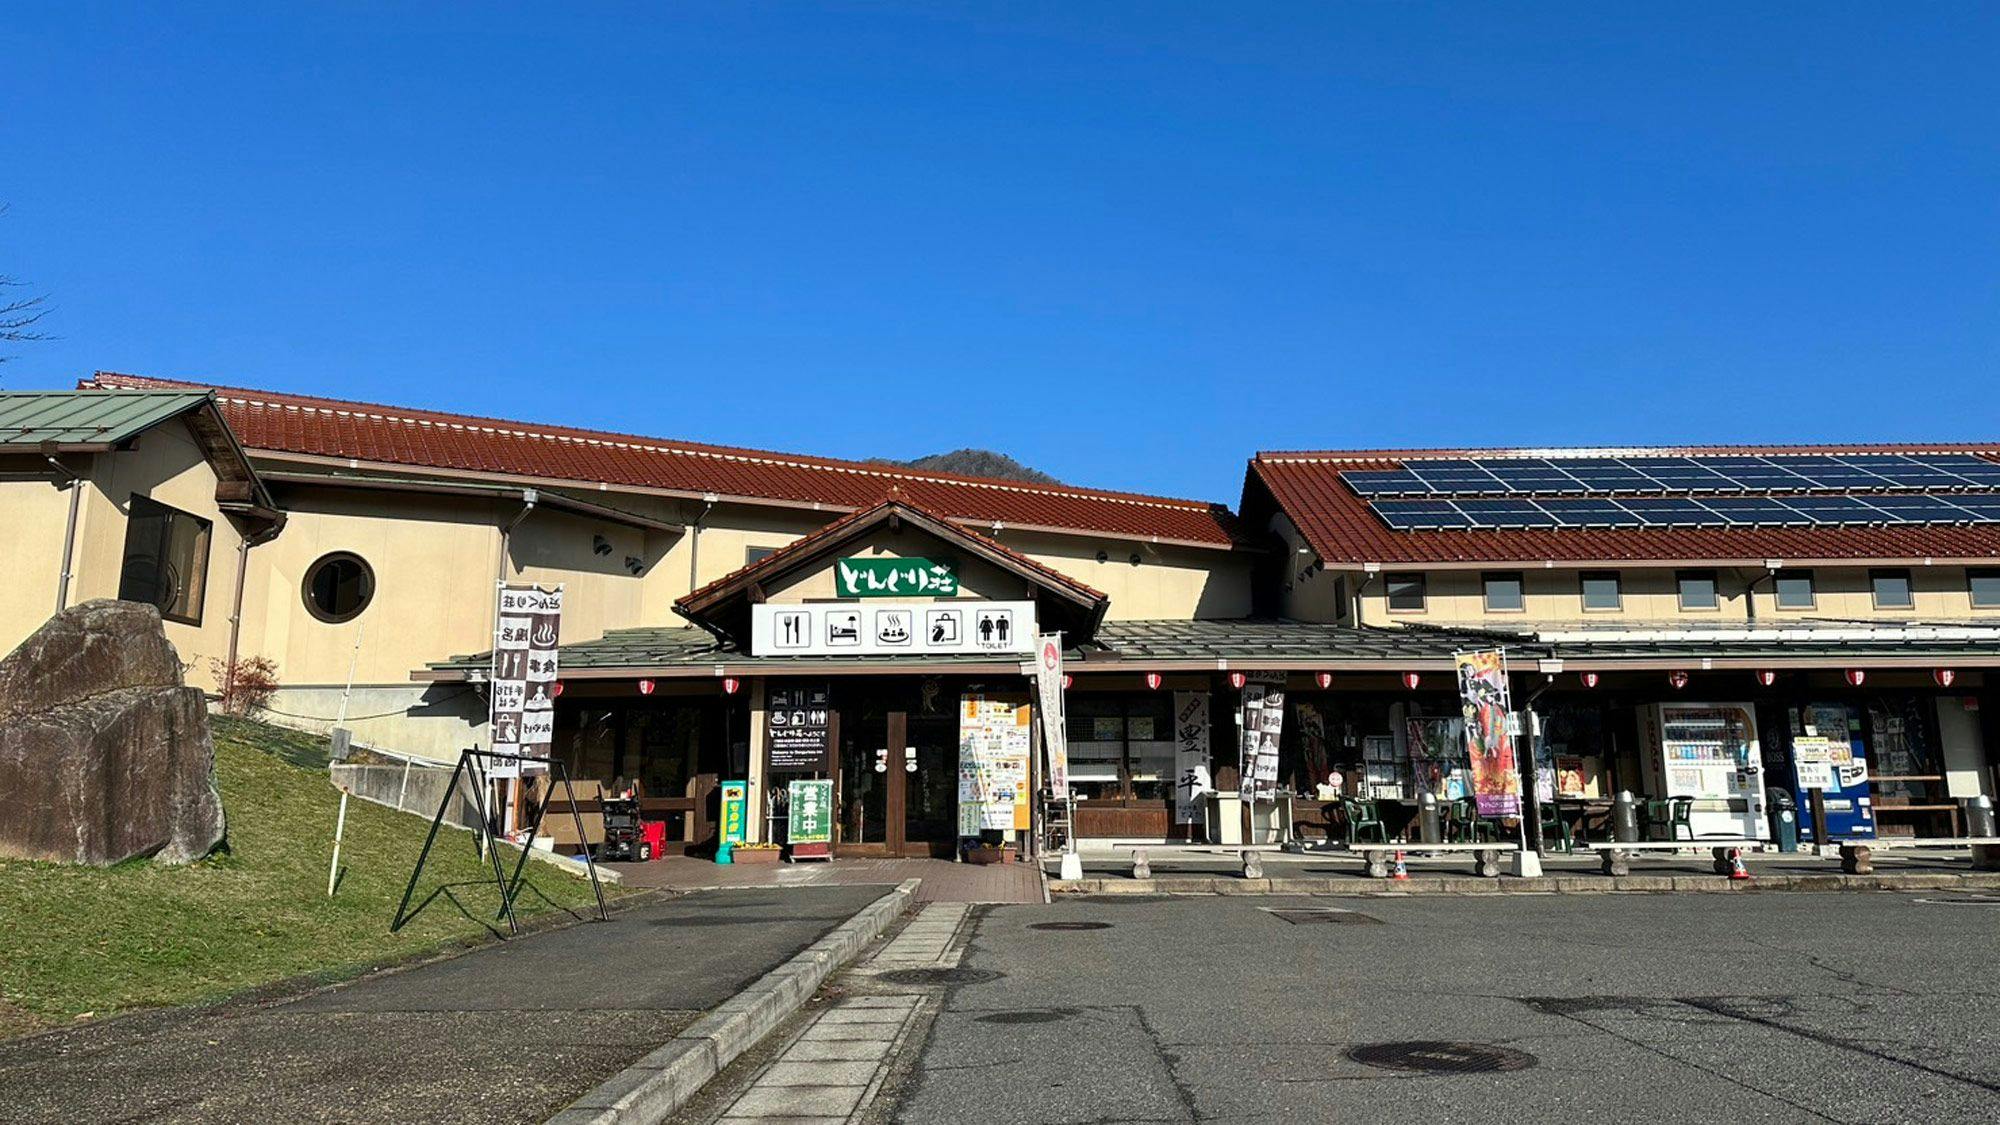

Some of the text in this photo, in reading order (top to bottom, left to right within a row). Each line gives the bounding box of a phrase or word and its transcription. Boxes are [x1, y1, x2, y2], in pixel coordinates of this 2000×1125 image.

[840, 561, 955, 593] どんぐり荘
[802, 784, 818, 834] 営業中
